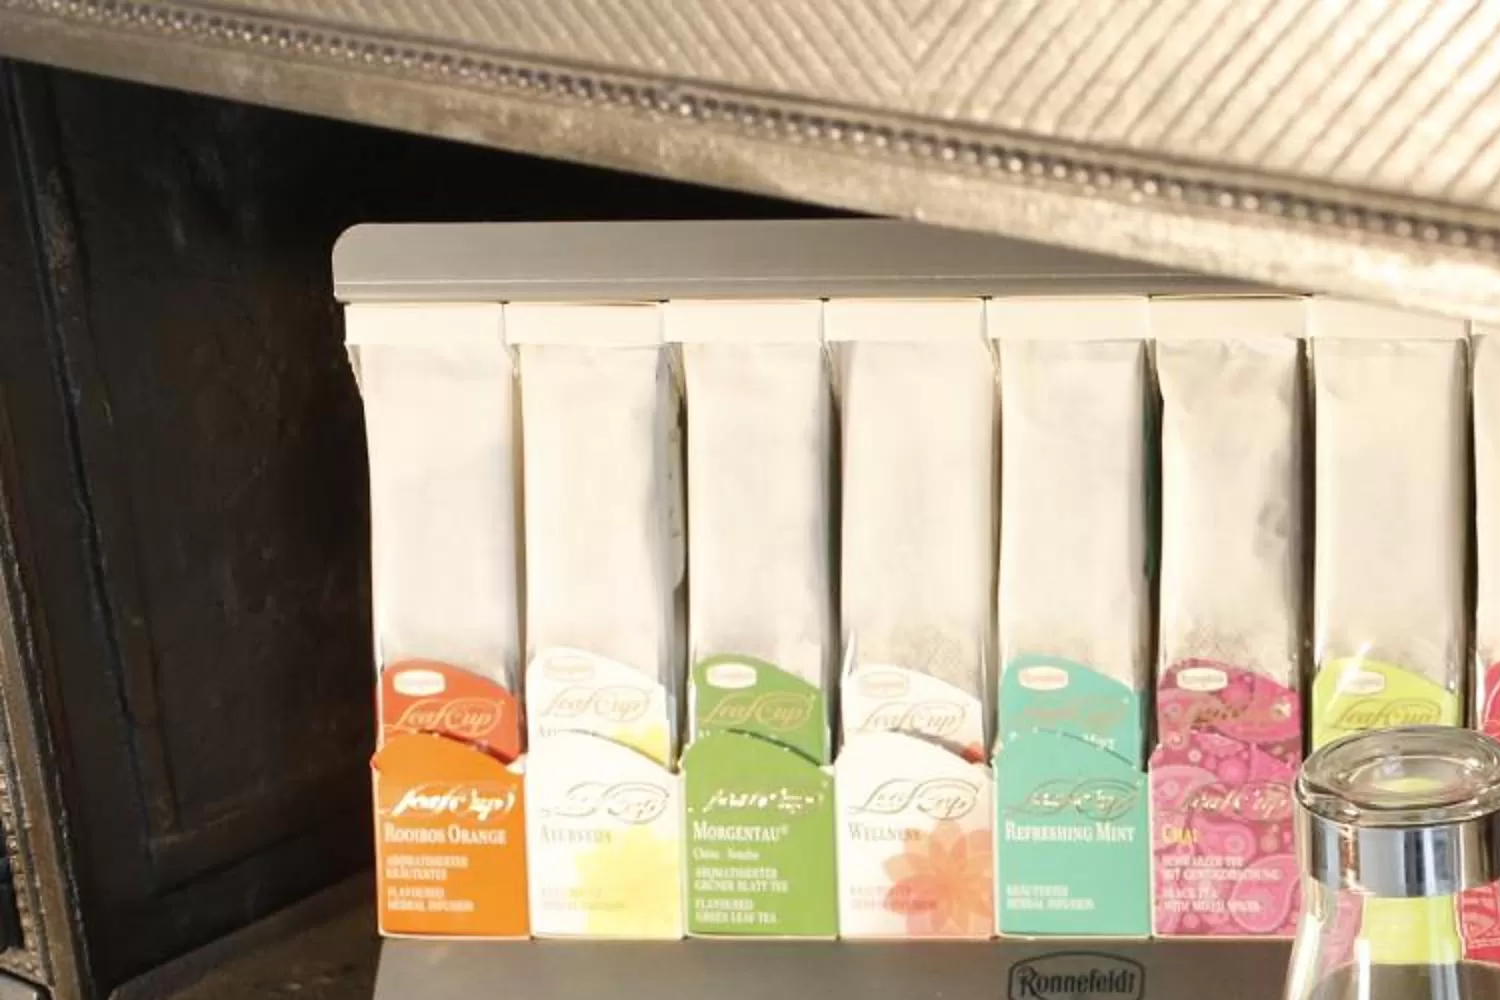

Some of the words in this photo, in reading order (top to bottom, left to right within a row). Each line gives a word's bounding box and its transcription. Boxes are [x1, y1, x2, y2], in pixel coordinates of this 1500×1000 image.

[447, 823, 507, 845] ORANGE
[1004, 820, 1093, 842] REFRESHING
[1095, 821, 1136, 842] MINT
